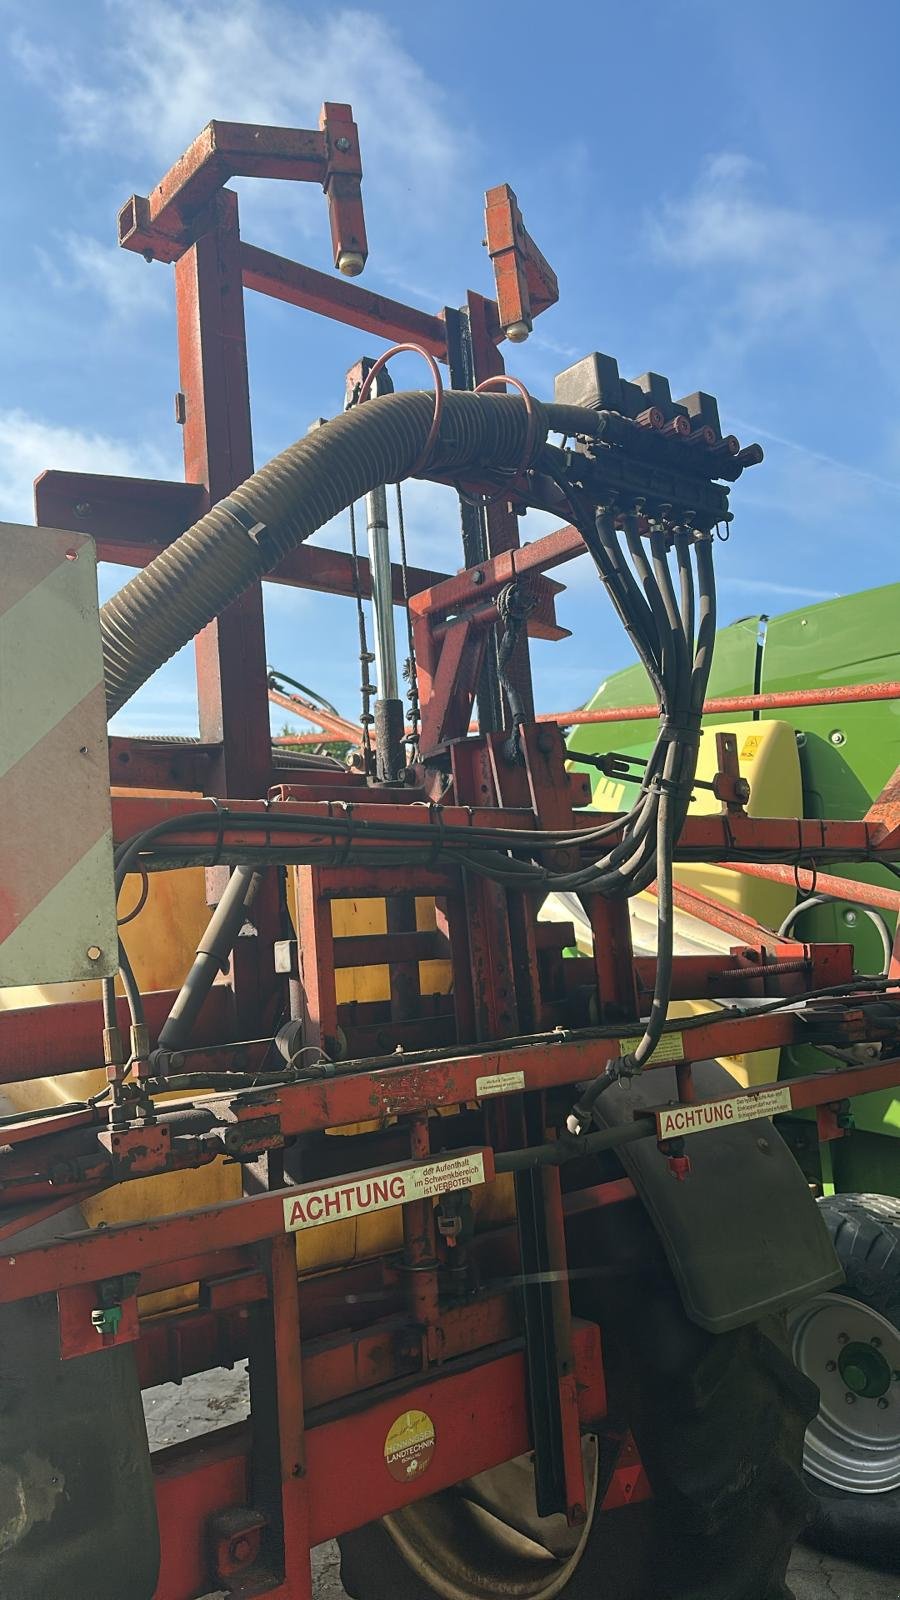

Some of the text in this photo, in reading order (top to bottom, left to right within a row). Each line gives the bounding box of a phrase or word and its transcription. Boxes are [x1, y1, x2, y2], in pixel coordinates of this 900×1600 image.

[665, 1103, 734, 1133] ACHTUNG
[414, 1165, 479, 1188] im Schwenkbereich
[423, 1158, 470, 1176] der Aufenthalt
[423, 1176, 472, 1195] ist VERBOTEN
[289, 1176, 406, 1226] ACHTUNG
[387, 1438, 435, 1464] LANDTECHNIK
